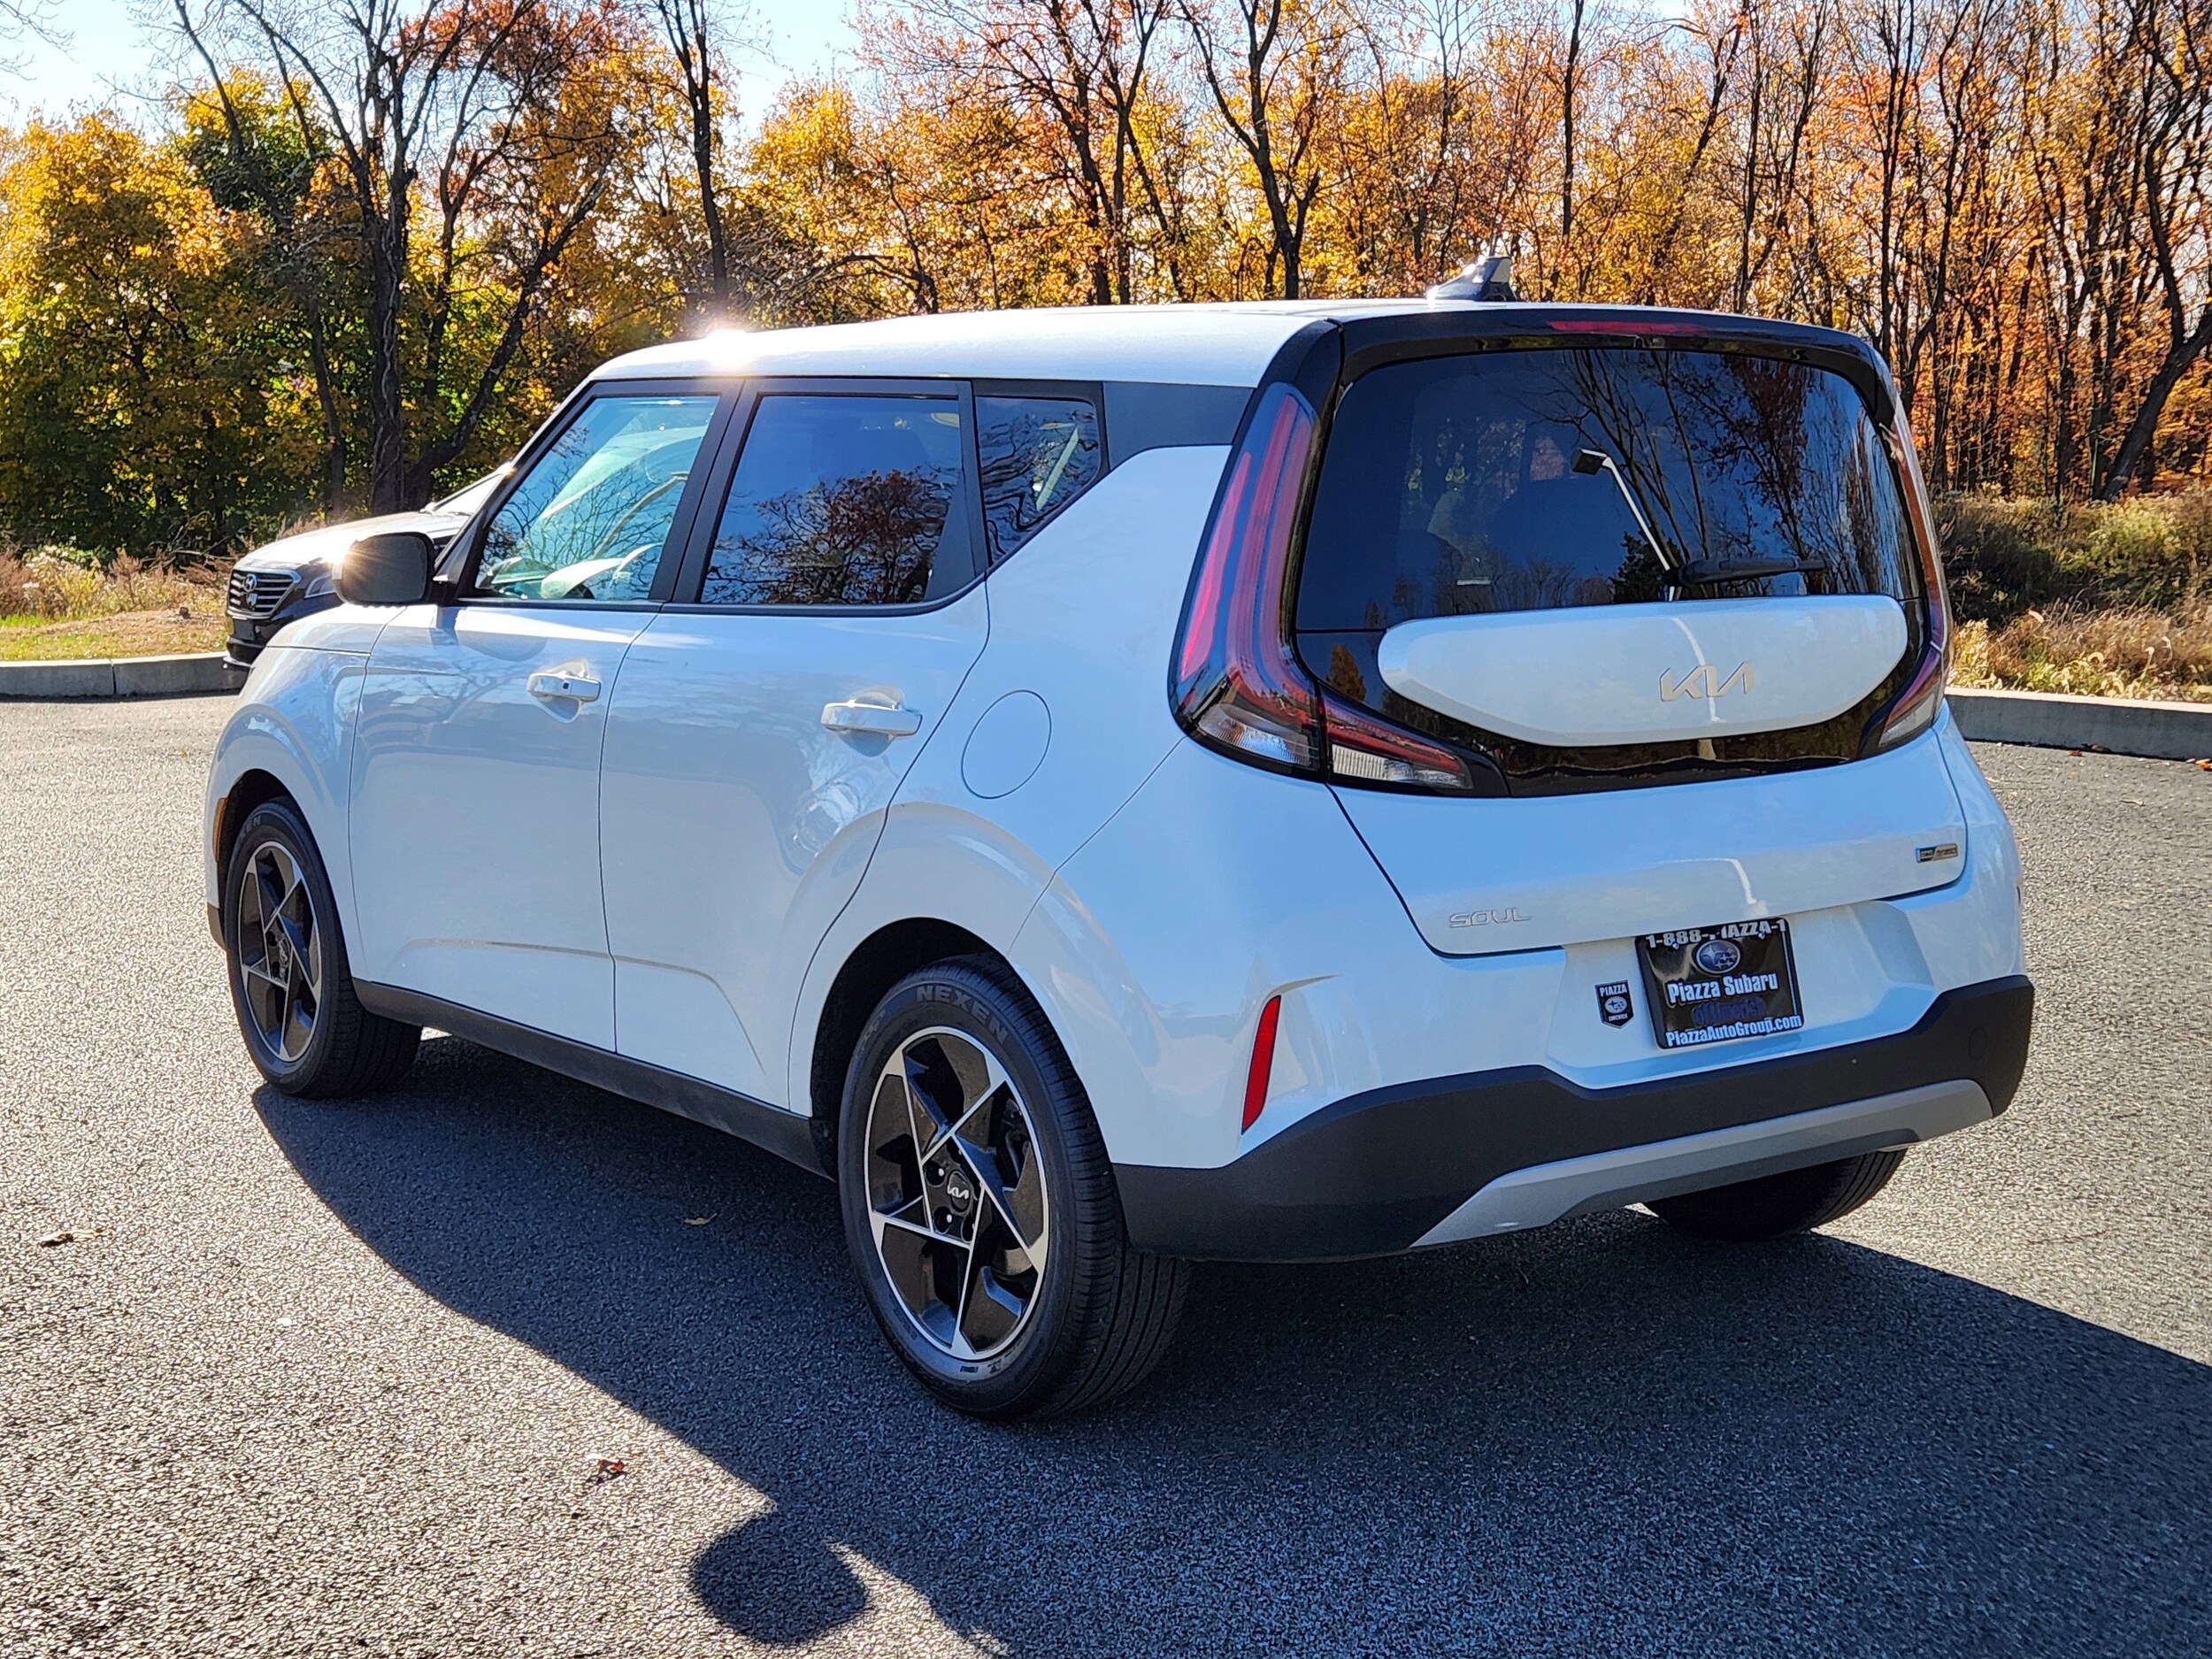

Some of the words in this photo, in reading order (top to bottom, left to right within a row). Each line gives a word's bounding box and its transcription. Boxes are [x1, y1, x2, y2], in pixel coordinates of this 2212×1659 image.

[1449, 907, 1532, 928] SOUL
[1600, 983, 1628, 997] PIAZZA
[1667, 980, 1721, 1003] Piazza
[1723, 973, 1778, 995] Subaru
[916, 985, 1009, 1042] NEXEN
[1665, 1015, 1802, 1047] PiazzaAutoGroup.com
